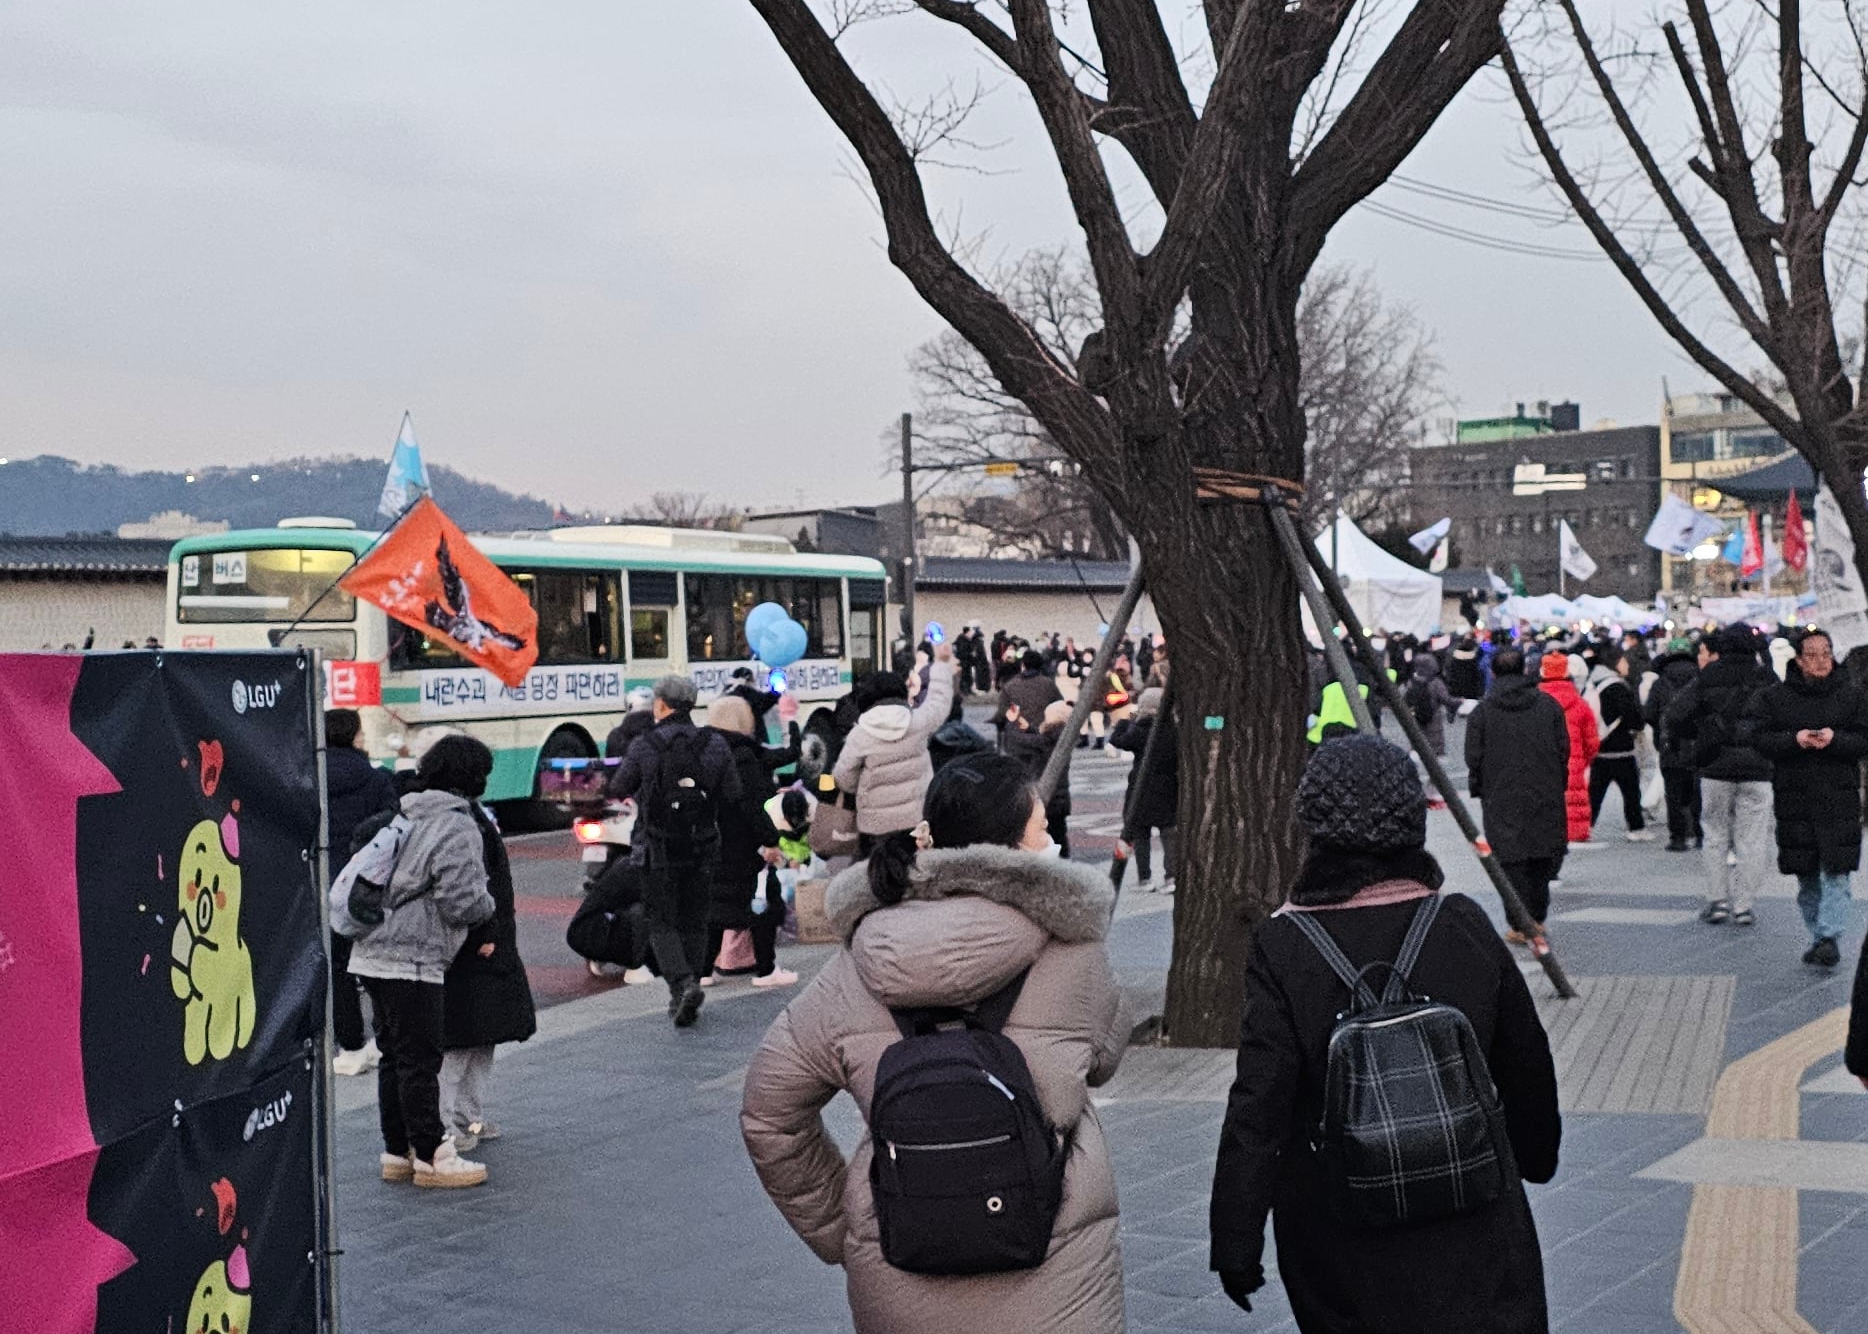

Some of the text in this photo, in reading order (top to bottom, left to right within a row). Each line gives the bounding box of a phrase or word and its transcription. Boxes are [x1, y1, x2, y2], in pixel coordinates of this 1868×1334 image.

[425, 675, 486, 706] 내란수괴
[531, 674, 558, 701] 당장
[565, 671, 620, 701] 파면하라
